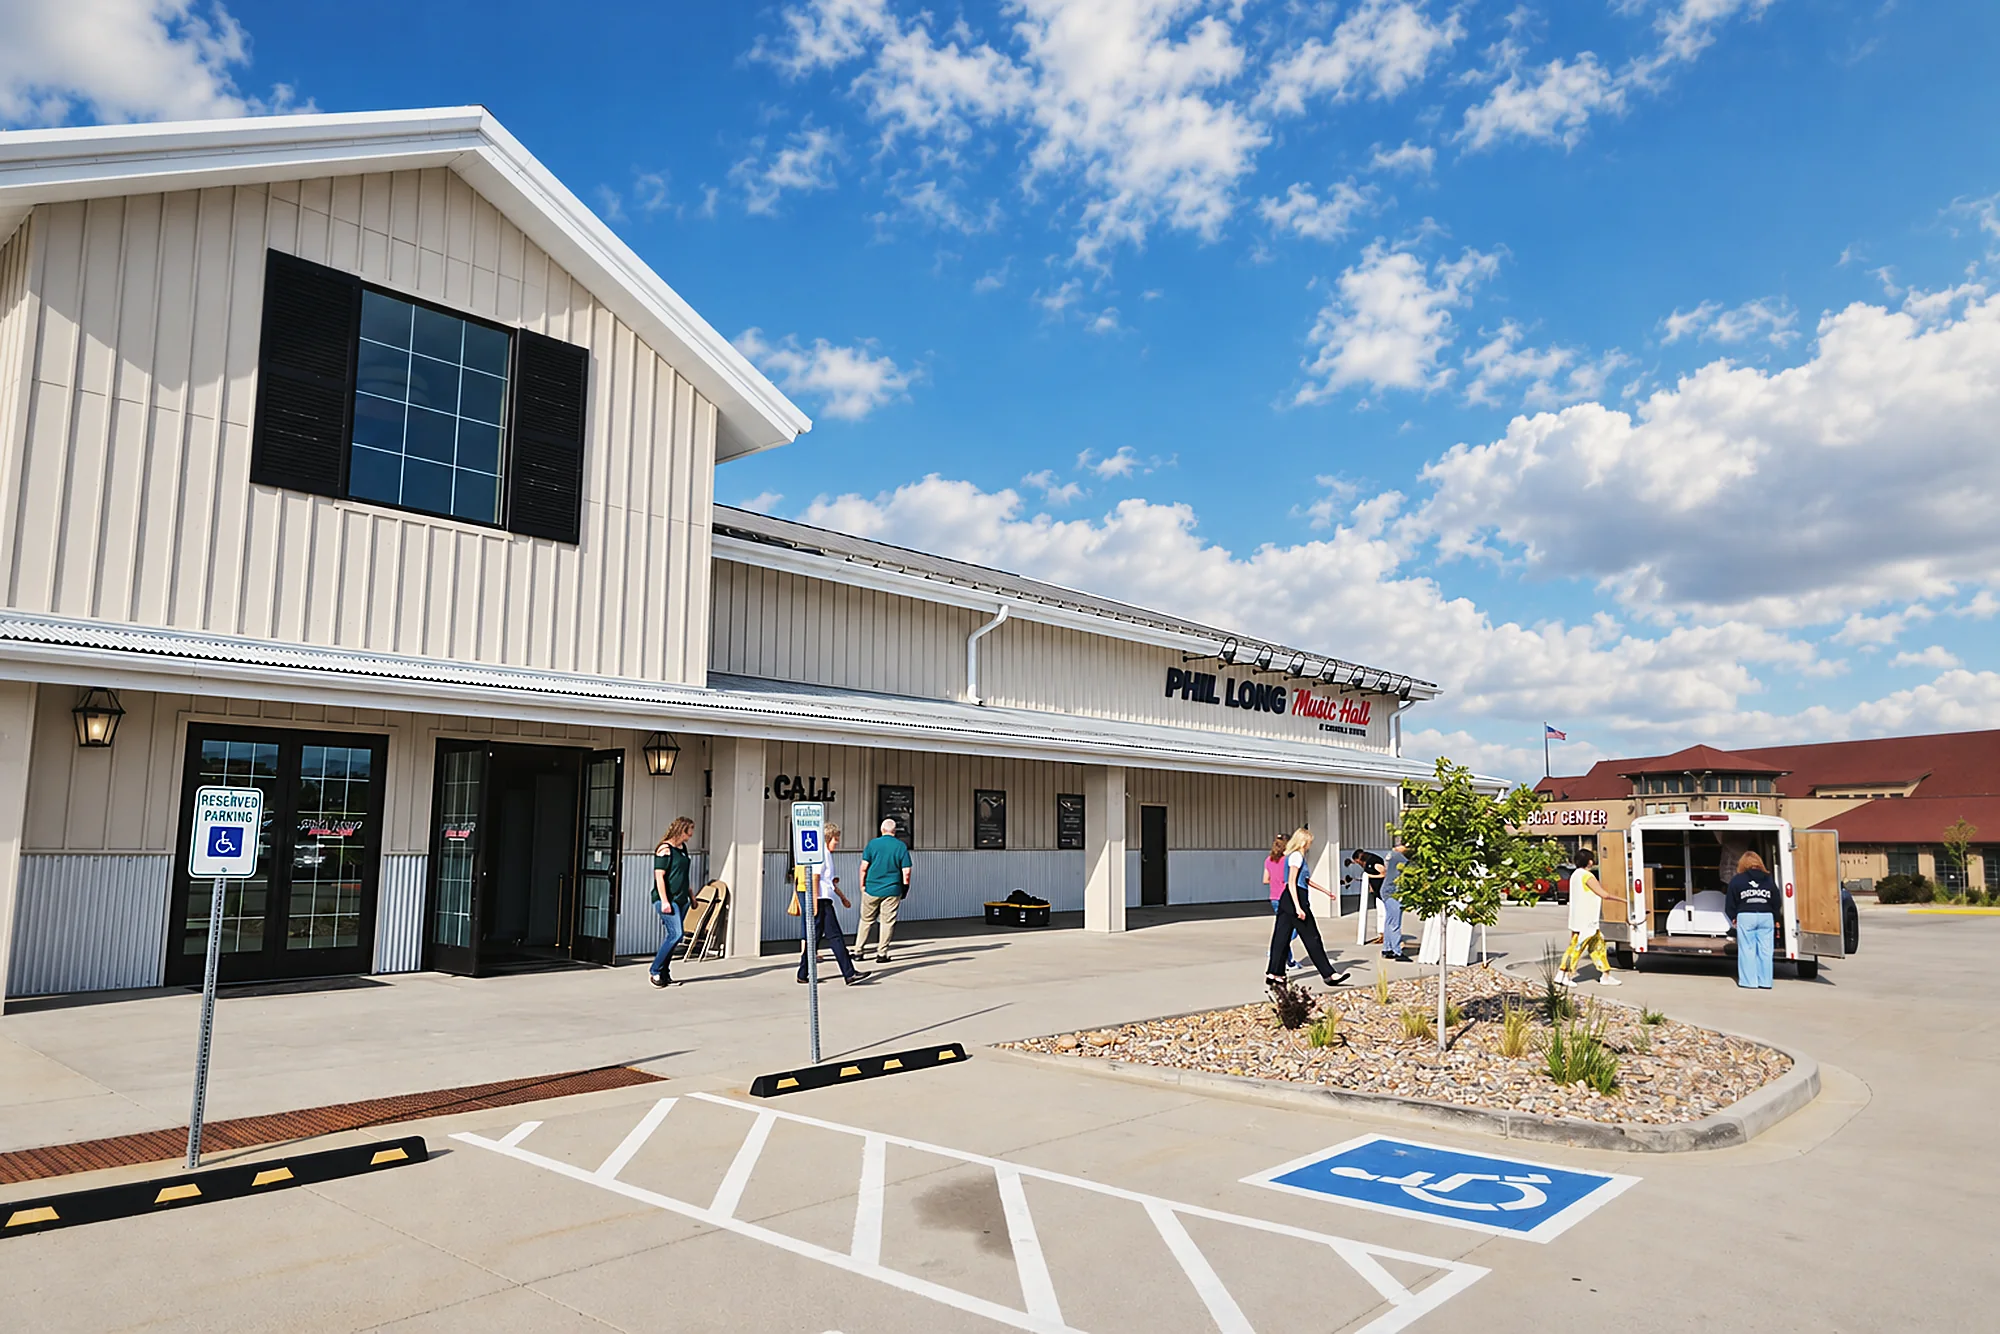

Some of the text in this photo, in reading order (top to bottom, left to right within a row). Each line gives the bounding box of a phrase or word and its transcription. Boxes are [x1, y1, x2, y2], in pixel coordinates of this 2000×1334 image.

[1165, 667, 1371, 726] PHIL LONG Music Hall
[774, 775, 836, 802] CALL
[201, 794, 258, 809] RESERVED
[204, 810, 253, 823] PARKING
[1527, 810, 1558, 825] BOAT
[1561, 810, 1608, 825] CENTER
